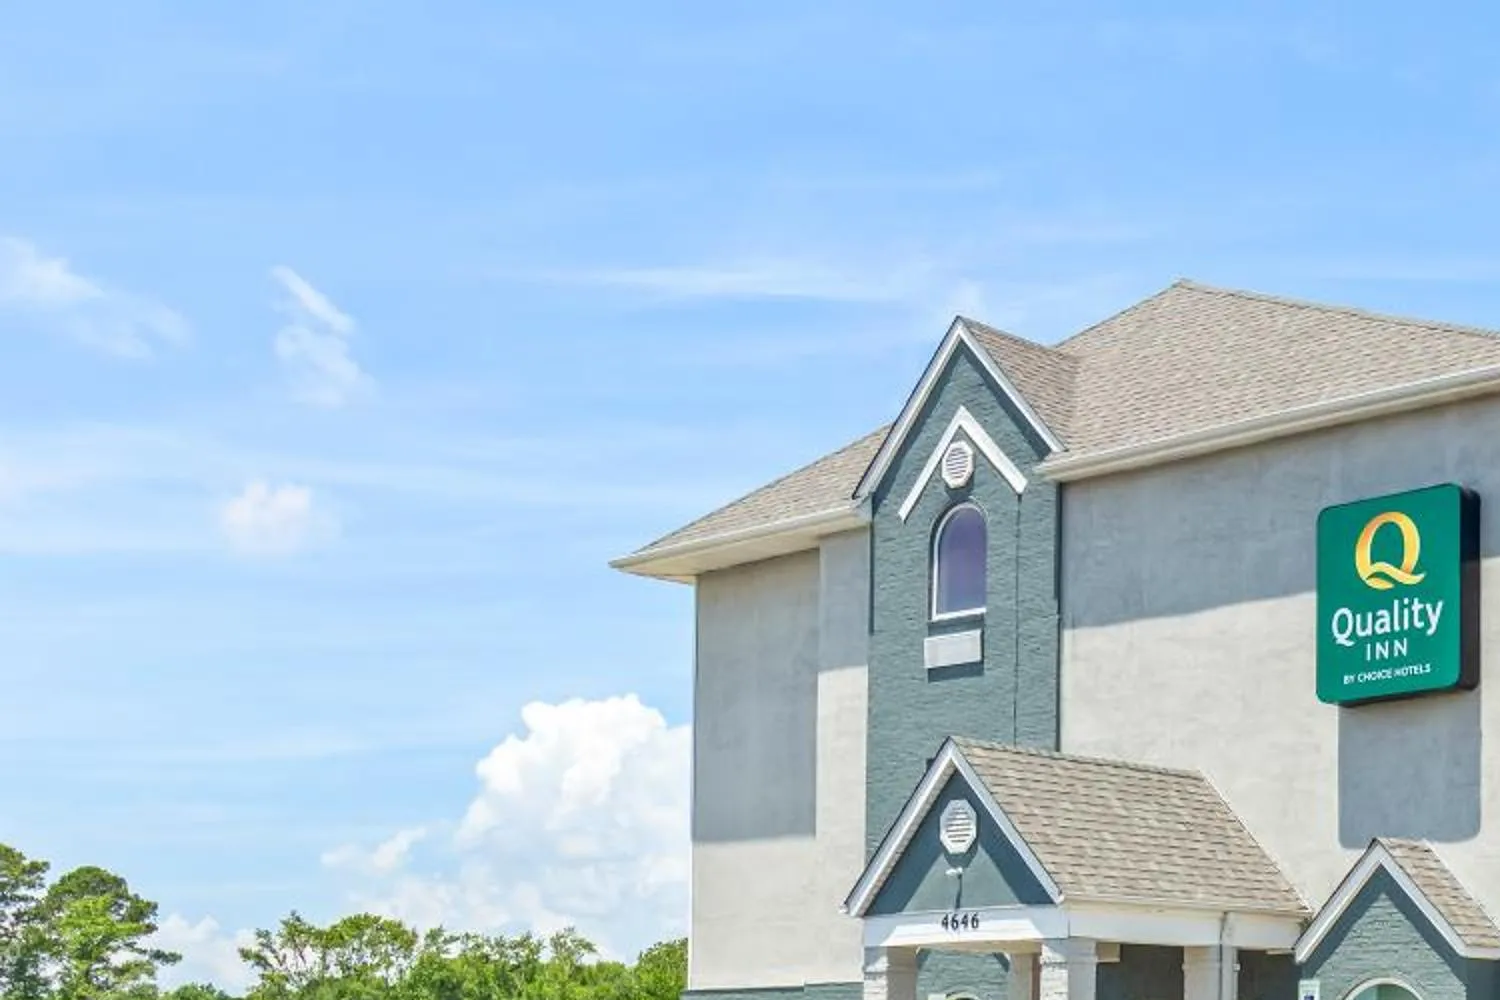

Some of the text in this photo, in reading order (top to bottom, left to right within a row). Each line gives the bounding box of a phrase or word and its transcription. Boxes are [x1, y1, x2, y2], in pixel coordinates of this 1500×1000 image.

[1355, 511, 1426, 590] Q
[1331, 597, 1444, 647] Quality
[1366, 638, 1408, 661] INN
[1343, 663, 1431, 685] BY CHOICE HOTELS
[941, 913, 979, 930] 4646
